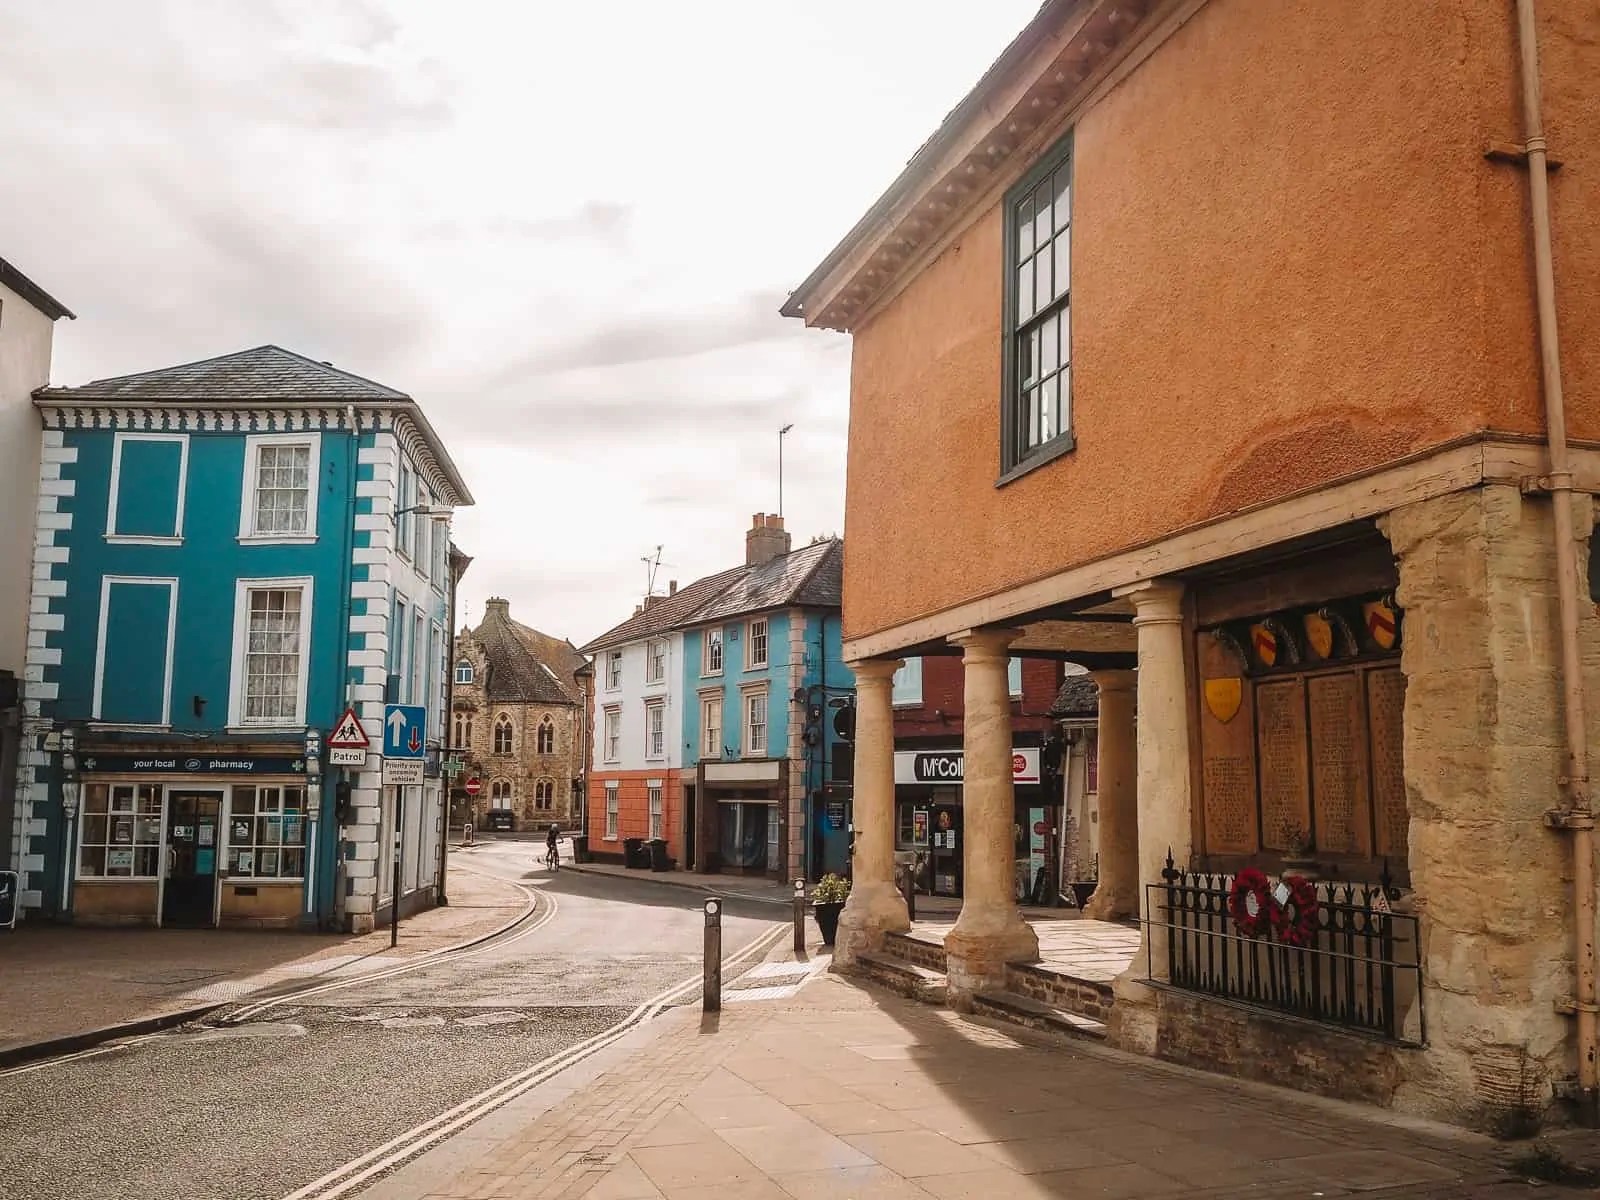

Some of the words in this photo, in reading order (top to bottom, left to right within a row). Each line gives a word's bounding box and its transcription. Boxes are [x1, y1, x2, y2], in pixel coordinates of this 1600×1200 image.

[333, 752, 361, 761] Patrol
[134, 760, 153, 769] your
[155, 759, 176, 768] local
[209, 759, 254, 770] pharmacy
